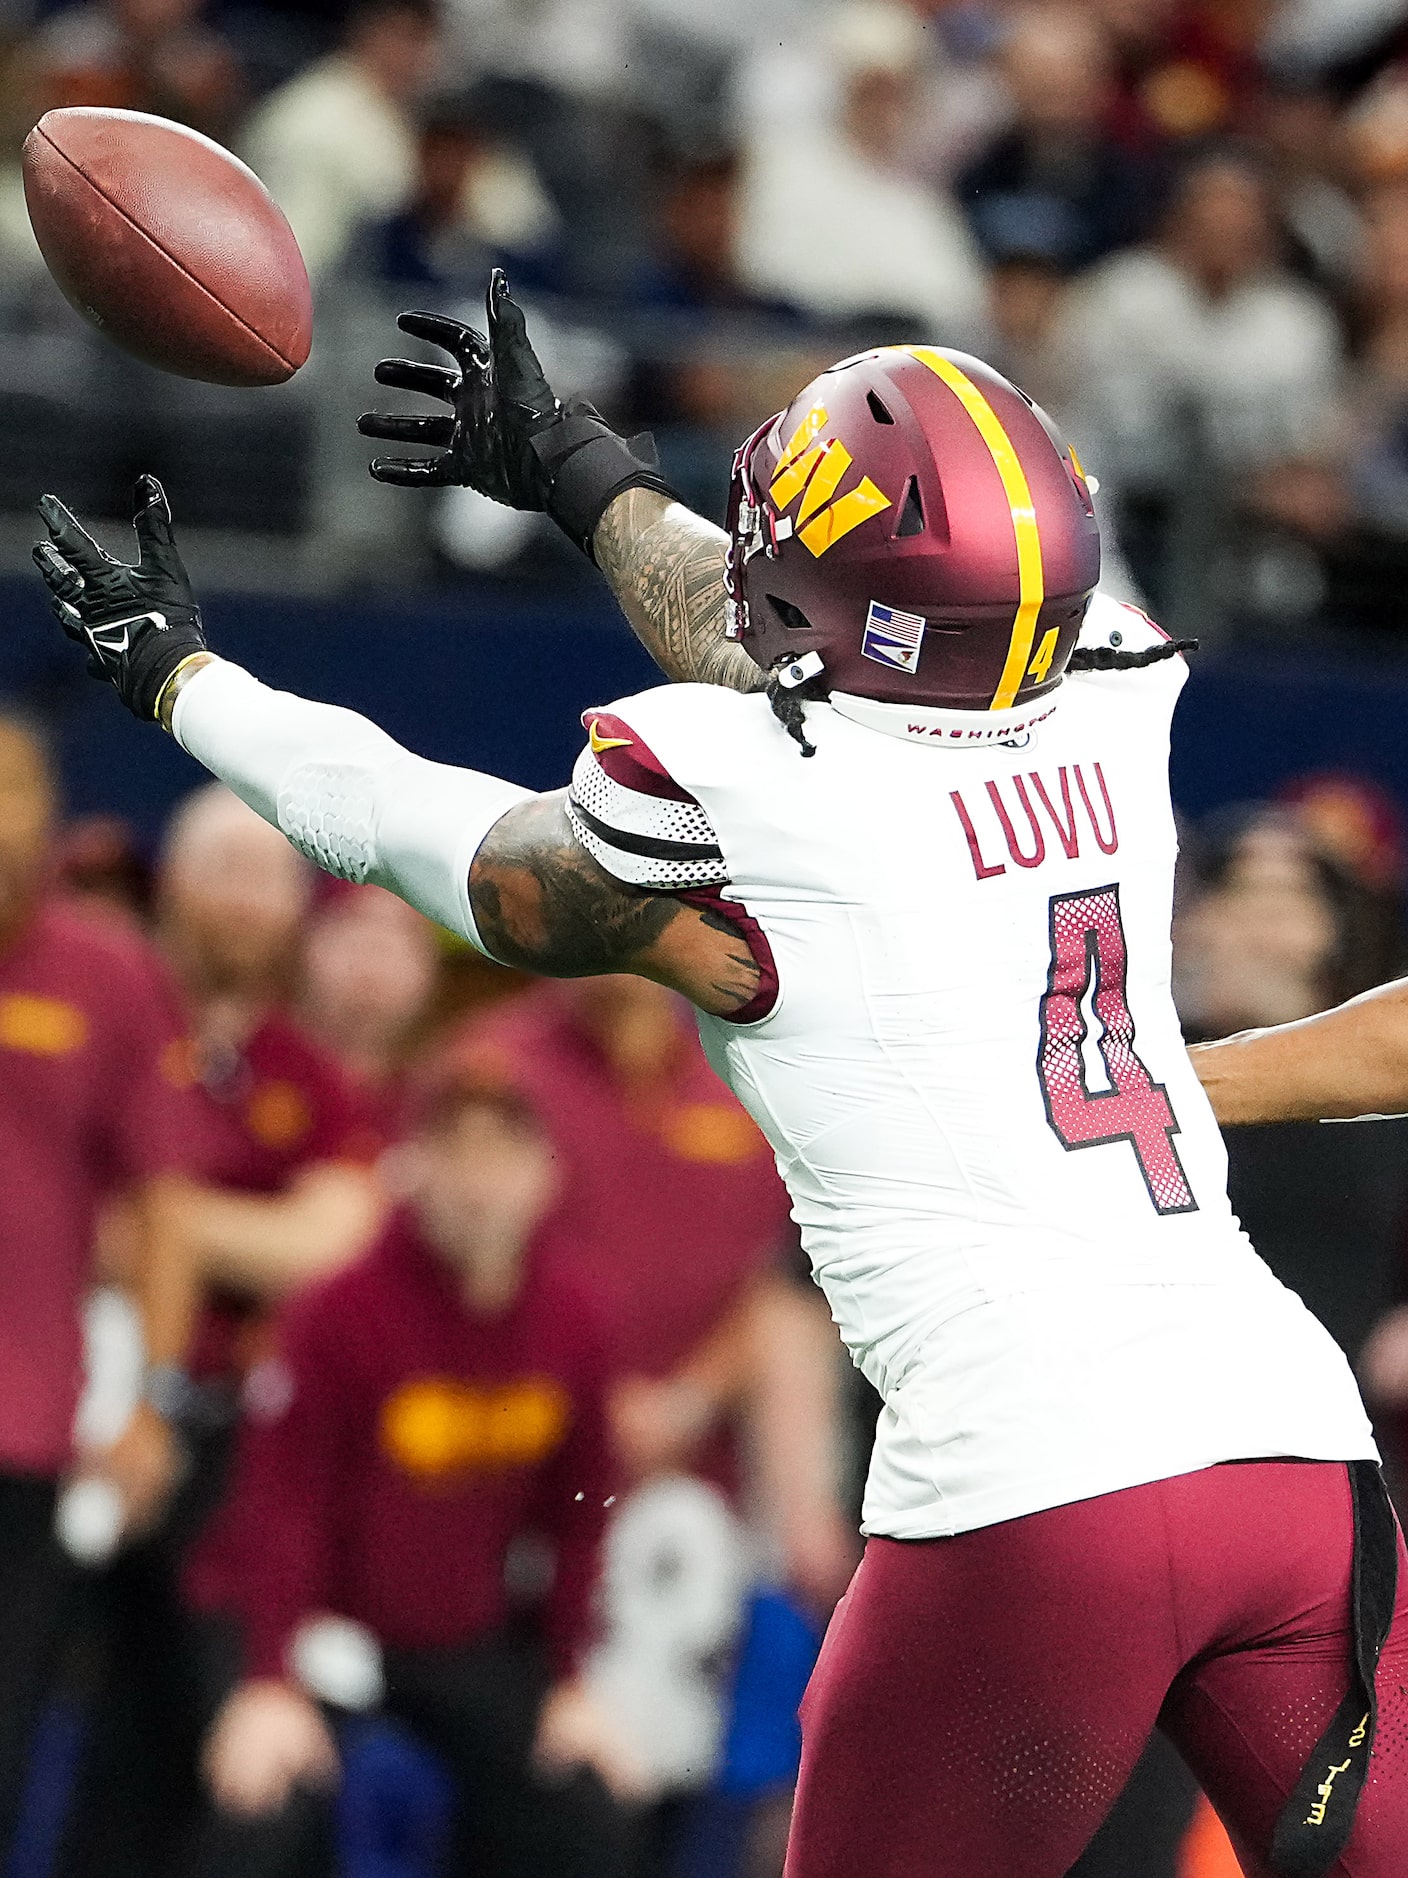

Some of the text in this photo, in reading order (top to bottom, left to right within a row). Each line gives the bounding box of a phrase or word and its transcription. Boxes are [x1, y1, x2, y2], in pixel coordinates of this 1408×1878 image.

[1027, 626, 1060, 684] 4
[907, 706, 1057, 738] WASHINGTON
[949, 762, 1119, 880] LUVU
[1037, 882, 1200, 1216] 4
